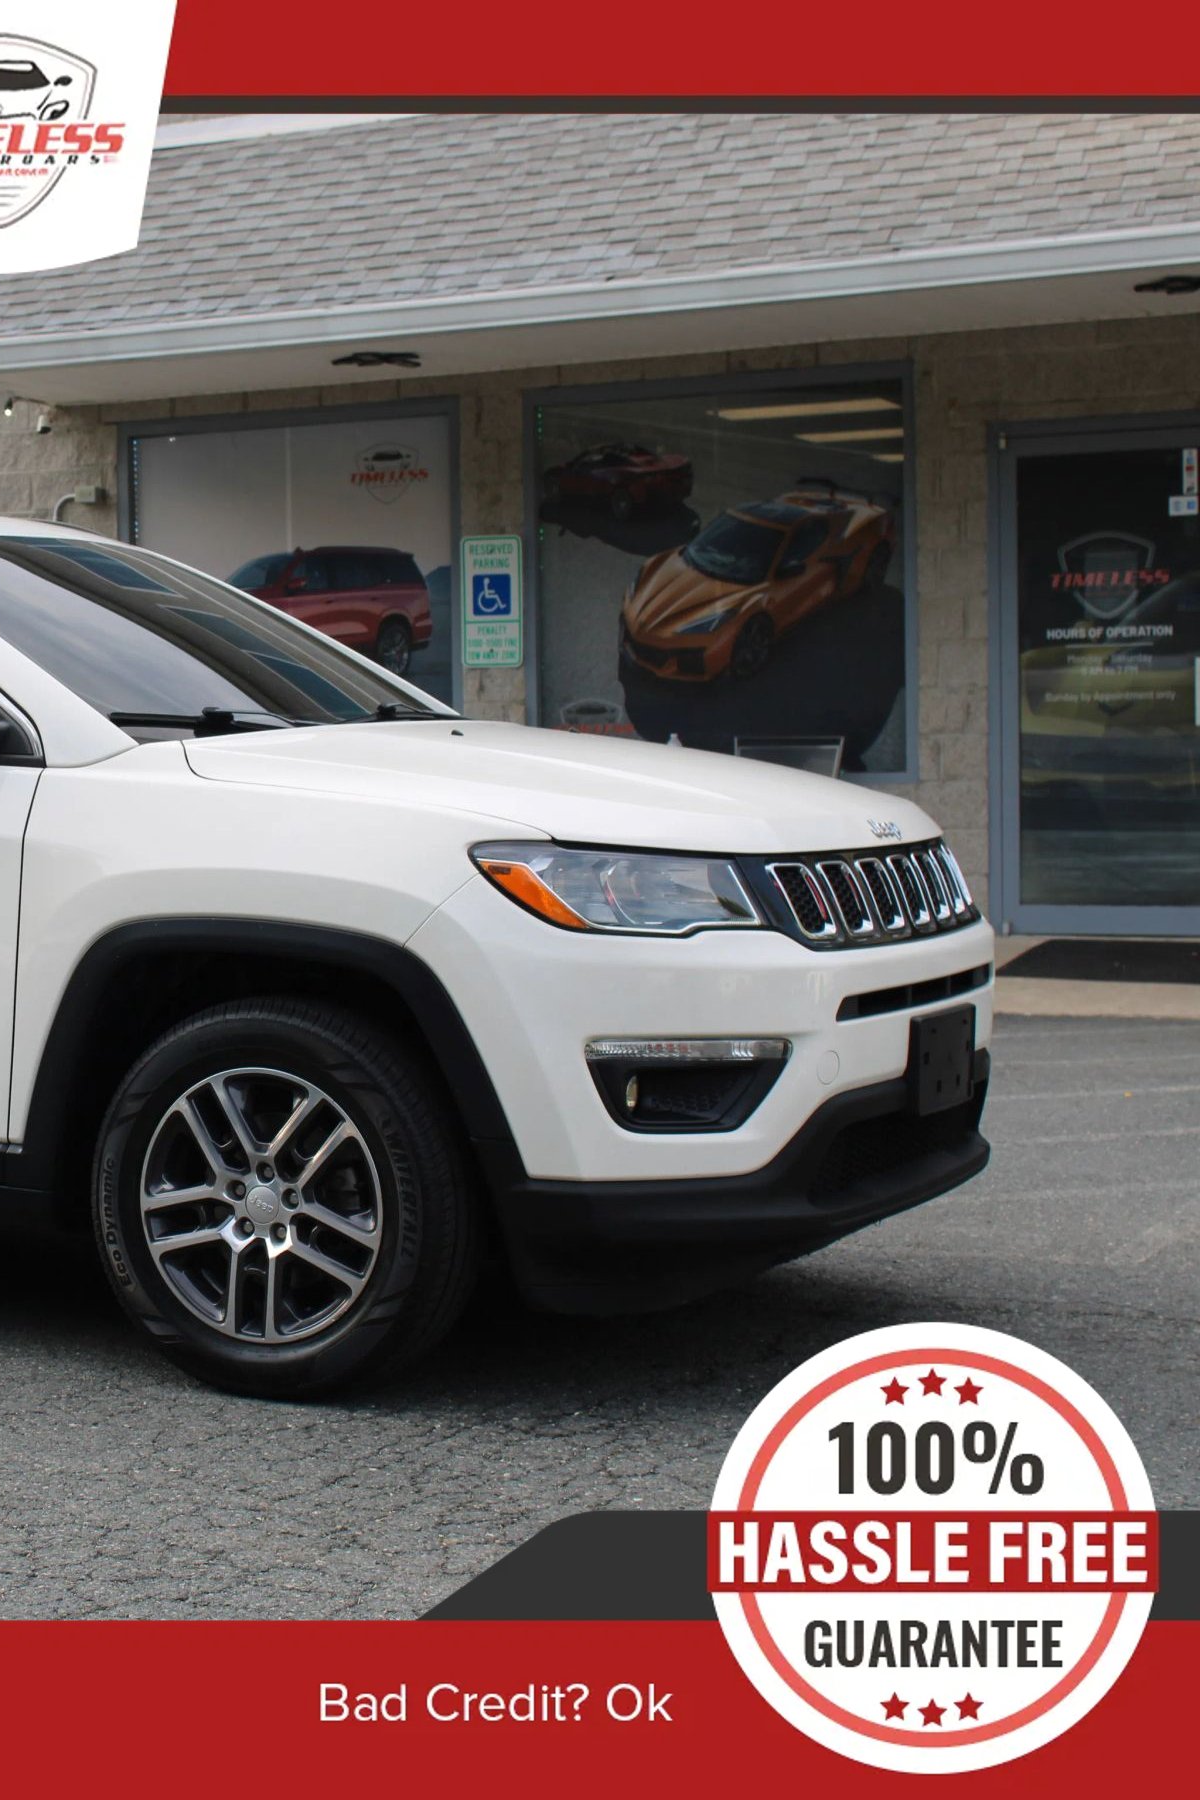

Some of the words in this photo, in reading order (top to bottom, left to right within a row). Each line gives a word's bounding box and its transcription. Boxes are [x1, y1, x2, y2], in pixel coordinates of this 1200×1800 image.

[350, 468, 429, 485] TIMELESS
[469, 543, 513, 556] RESERVED
[473, 558, 510, 569] PARKING
[1050, 569, 1170, 589] TIMELESS
[1046, 627, 1086, 640] HOURS
[1088, 626, 1104, 639] OF
[1106, 624, 1174, 638] OPERATION
[867, 818, 903, 841] Jeep
[103, 1157, 118, 1245] Dynamic
[248, 1193, 275, 1214] Jeep
[112, 1249, 133, 1287] Eco
